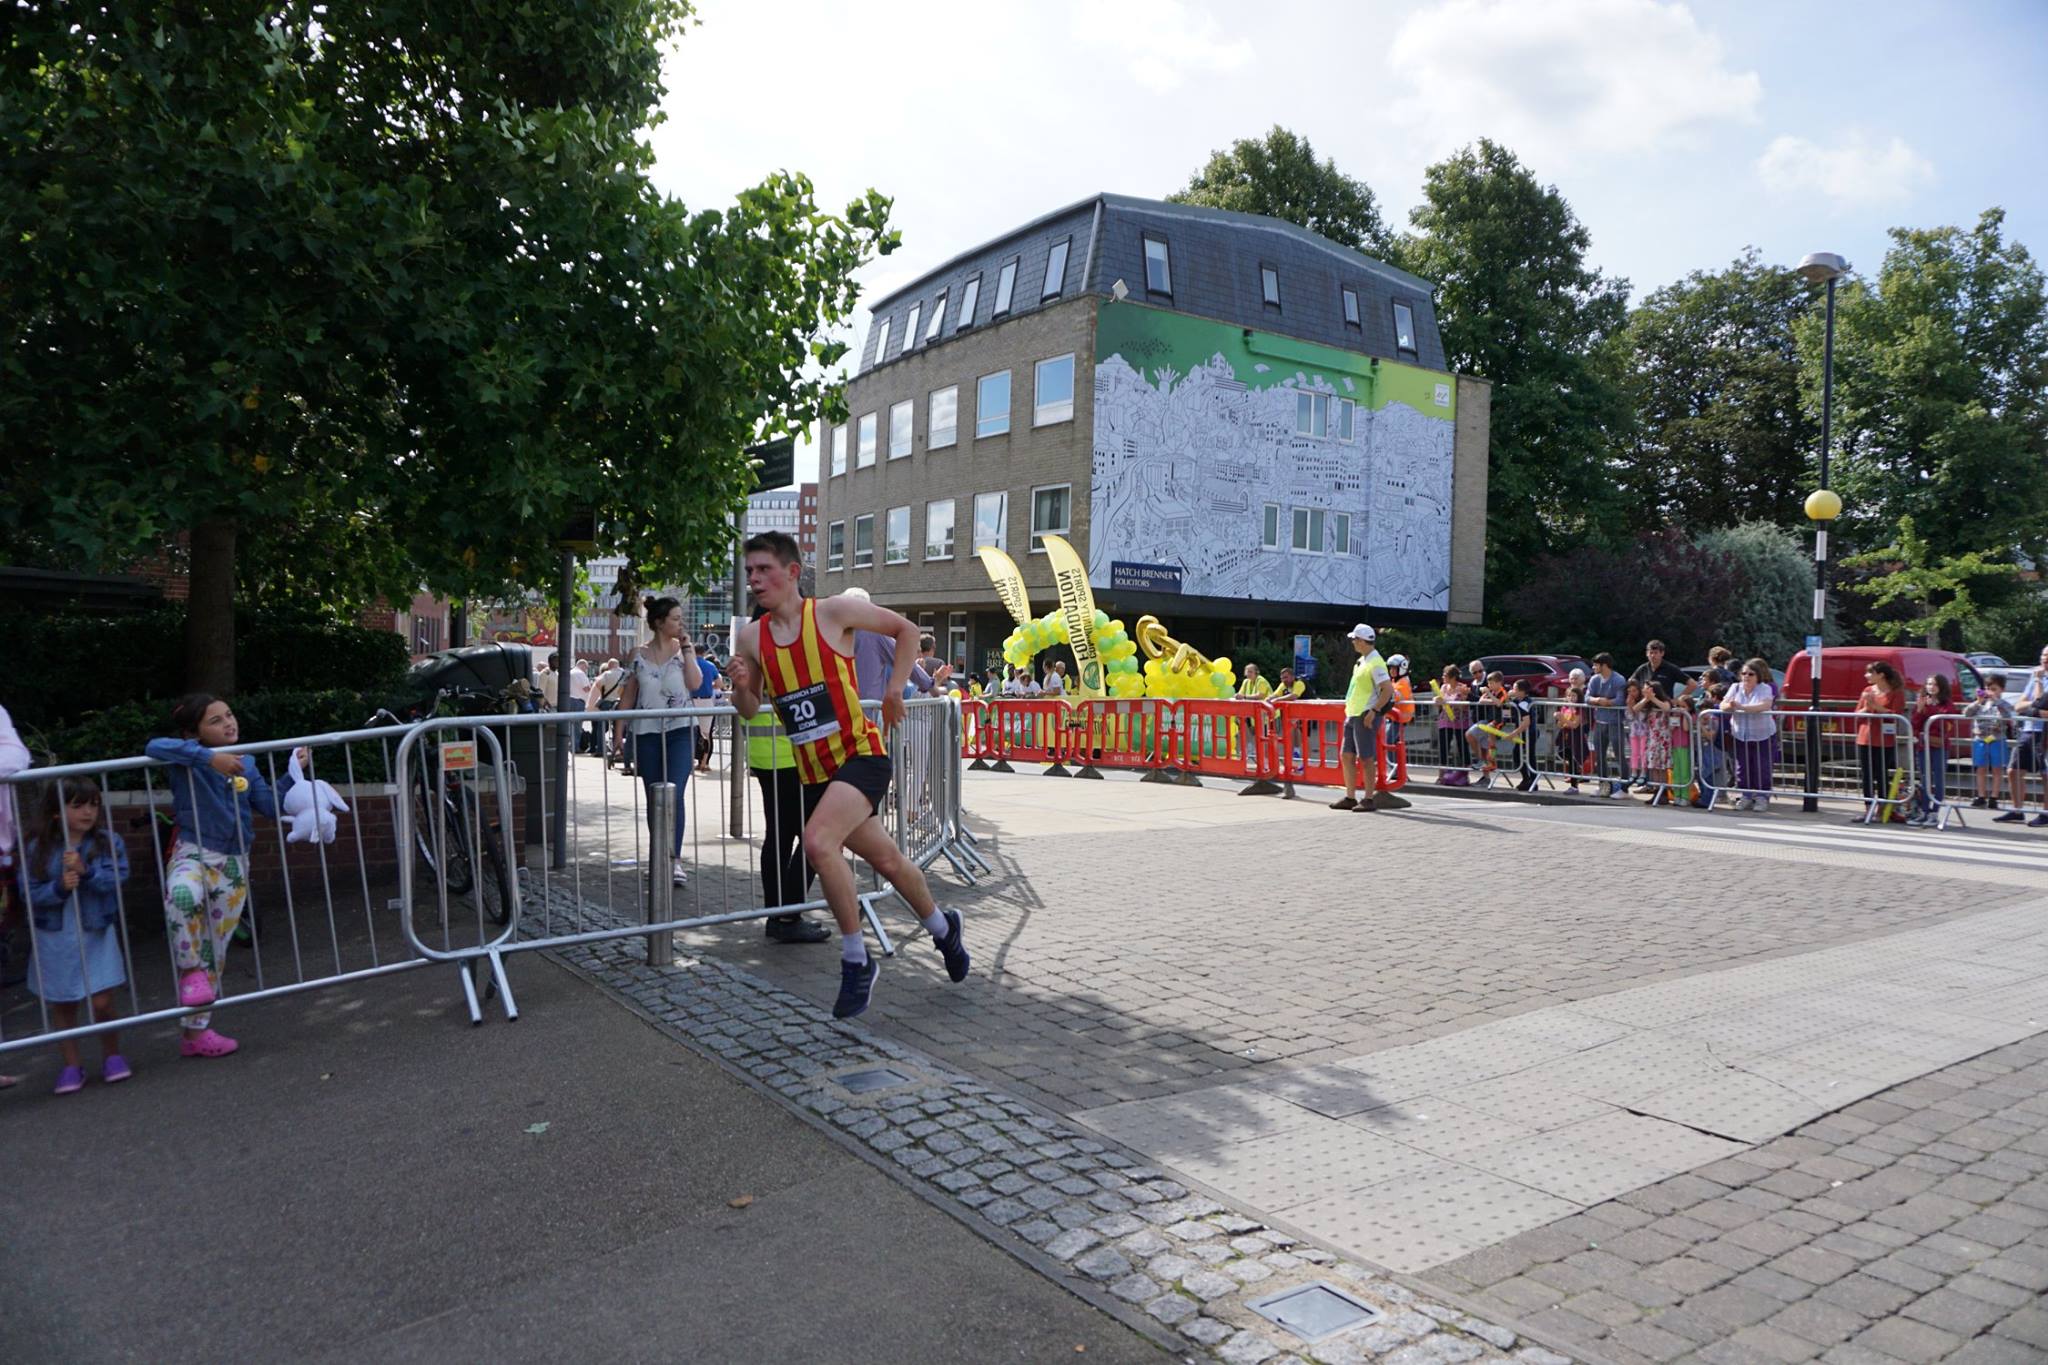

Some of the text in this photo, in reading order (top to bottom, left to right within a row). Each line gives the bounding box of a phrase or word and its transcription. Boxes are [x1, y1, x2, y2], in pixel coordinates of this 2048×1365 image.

[1114, 566, 1174, 580] HATCH BRENNER
[1114, 577, 1150, 588] SOLICITORS
[789, 700, 816, 722] 20
